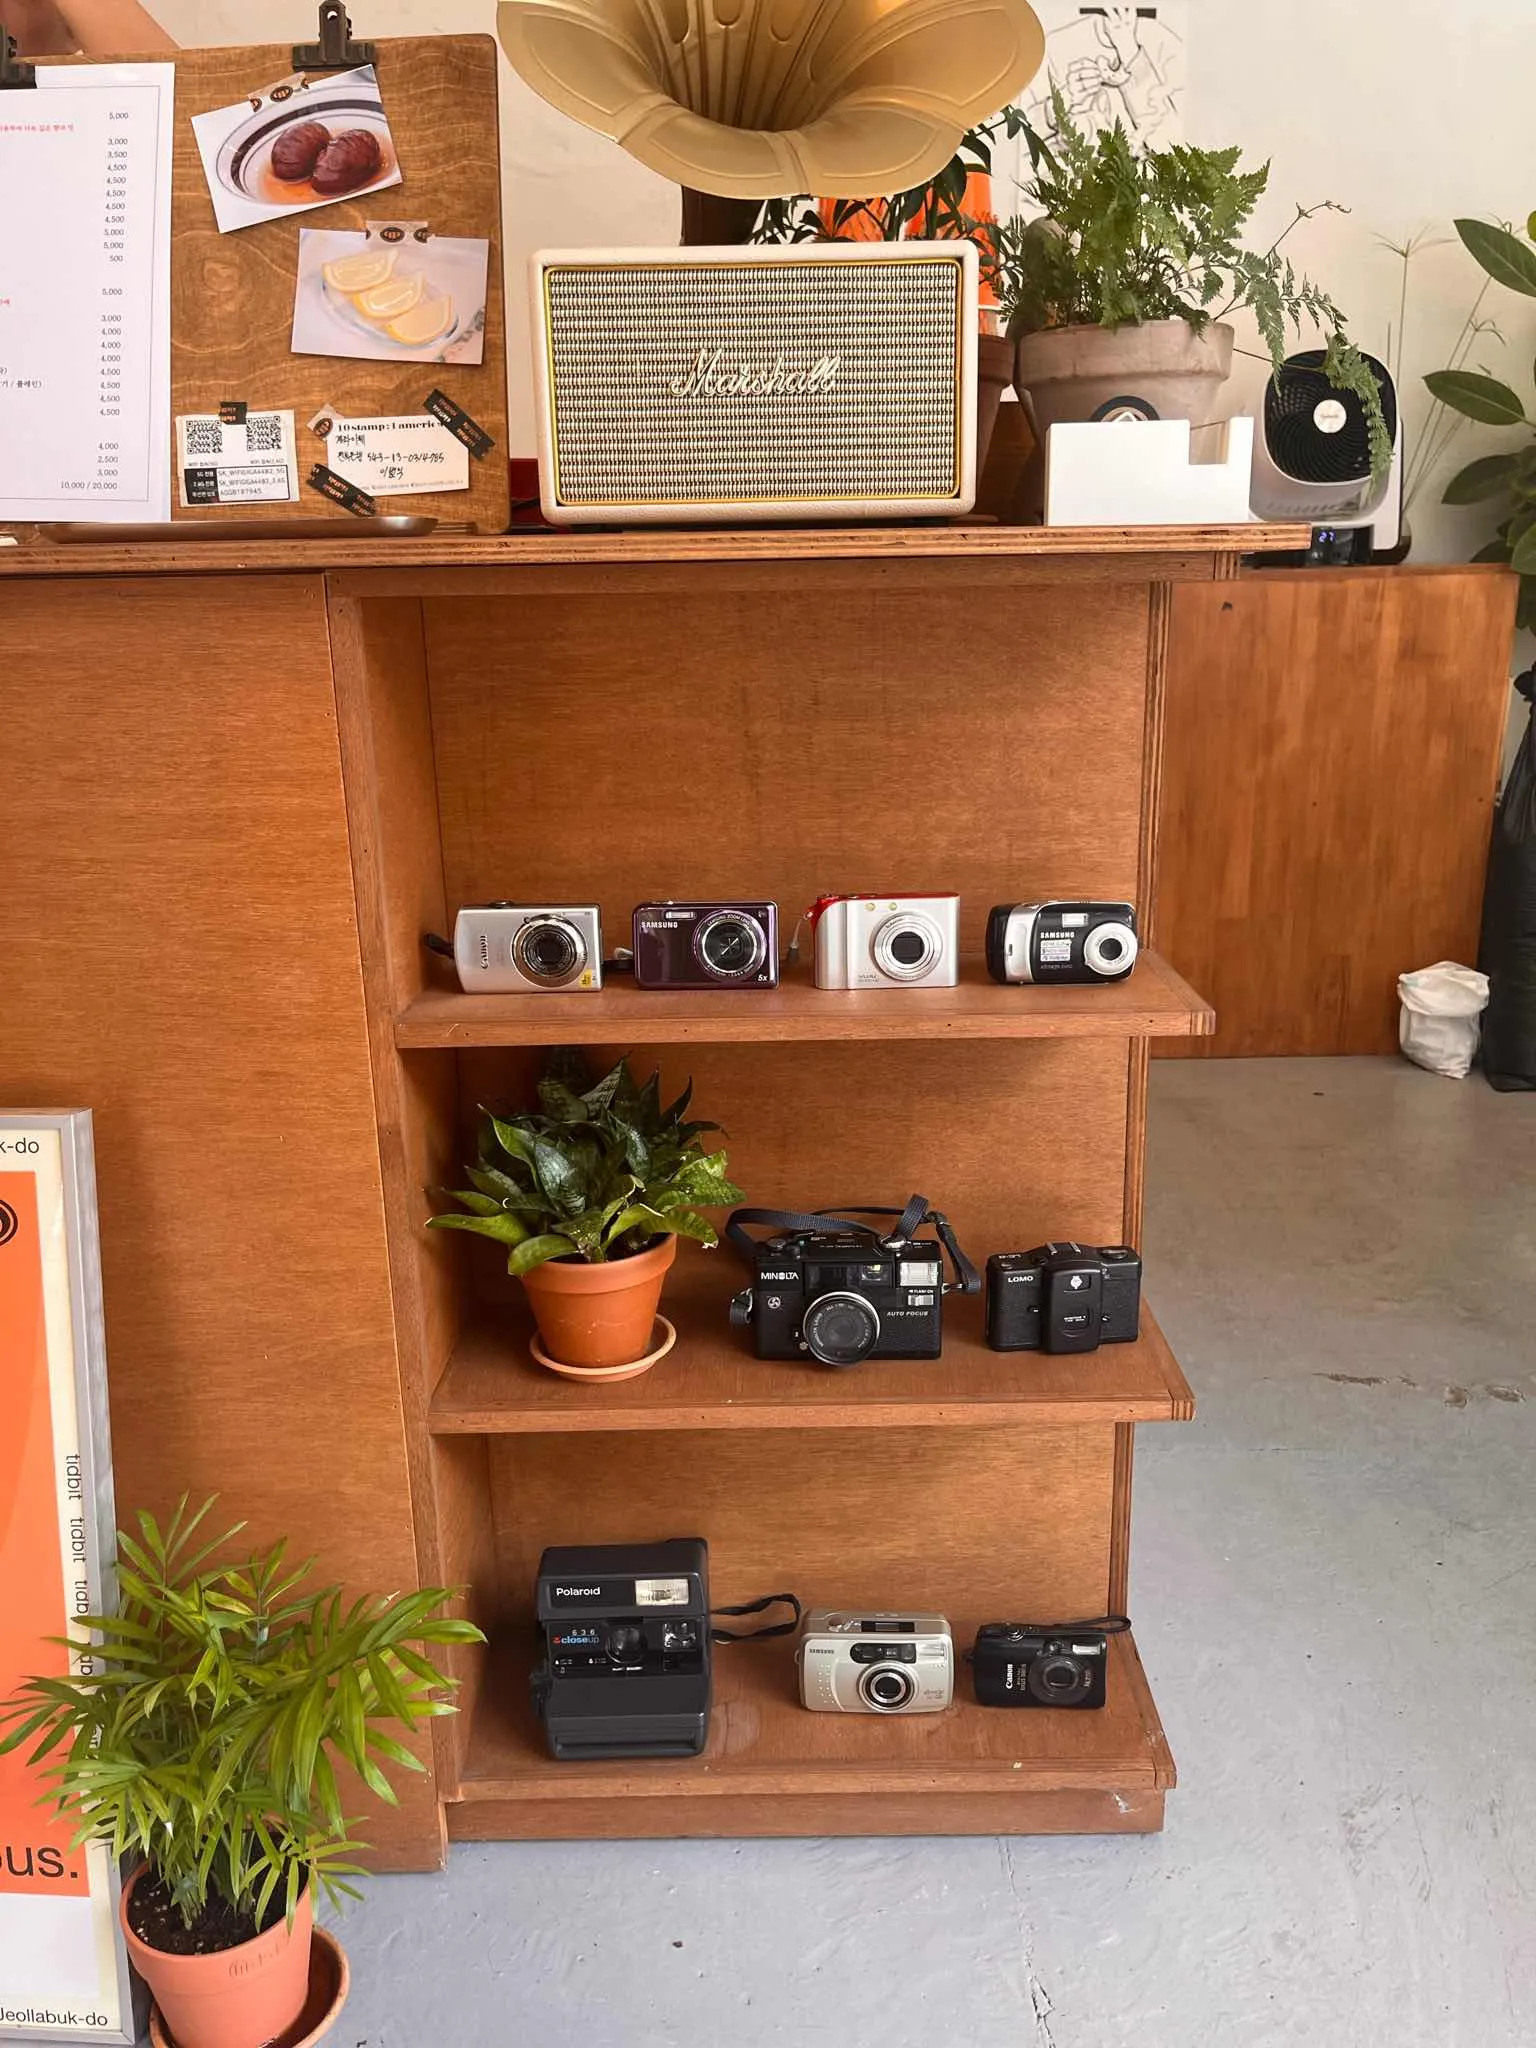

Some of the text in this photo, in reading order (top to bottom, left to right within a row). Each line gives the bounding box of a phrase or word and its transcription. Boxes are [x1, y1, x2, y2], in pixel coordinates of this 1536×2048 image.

[668, 348, 841, 397] Marshall
[640, 921, 678, 929] SAMSUNG
[1040, 931, 1075, 939] SAMSUNG
[480, 935, 489, 970] Canon
[757, 973, 768, 982] 5x
[760, 1271, 799, 1280] MINOLTA
[1007, 1275, 1034, 1284] LOMO
[65, 1453, 89, 1614] tidbit tidbit tidb
[556, 1586, 601, 1597] Polaroid
[1005, 1663, 1014, 1690] Canon
[0, 1845, 78, 1878] us.
[0, 2007, 108, 2027] Jeollabuk-do
